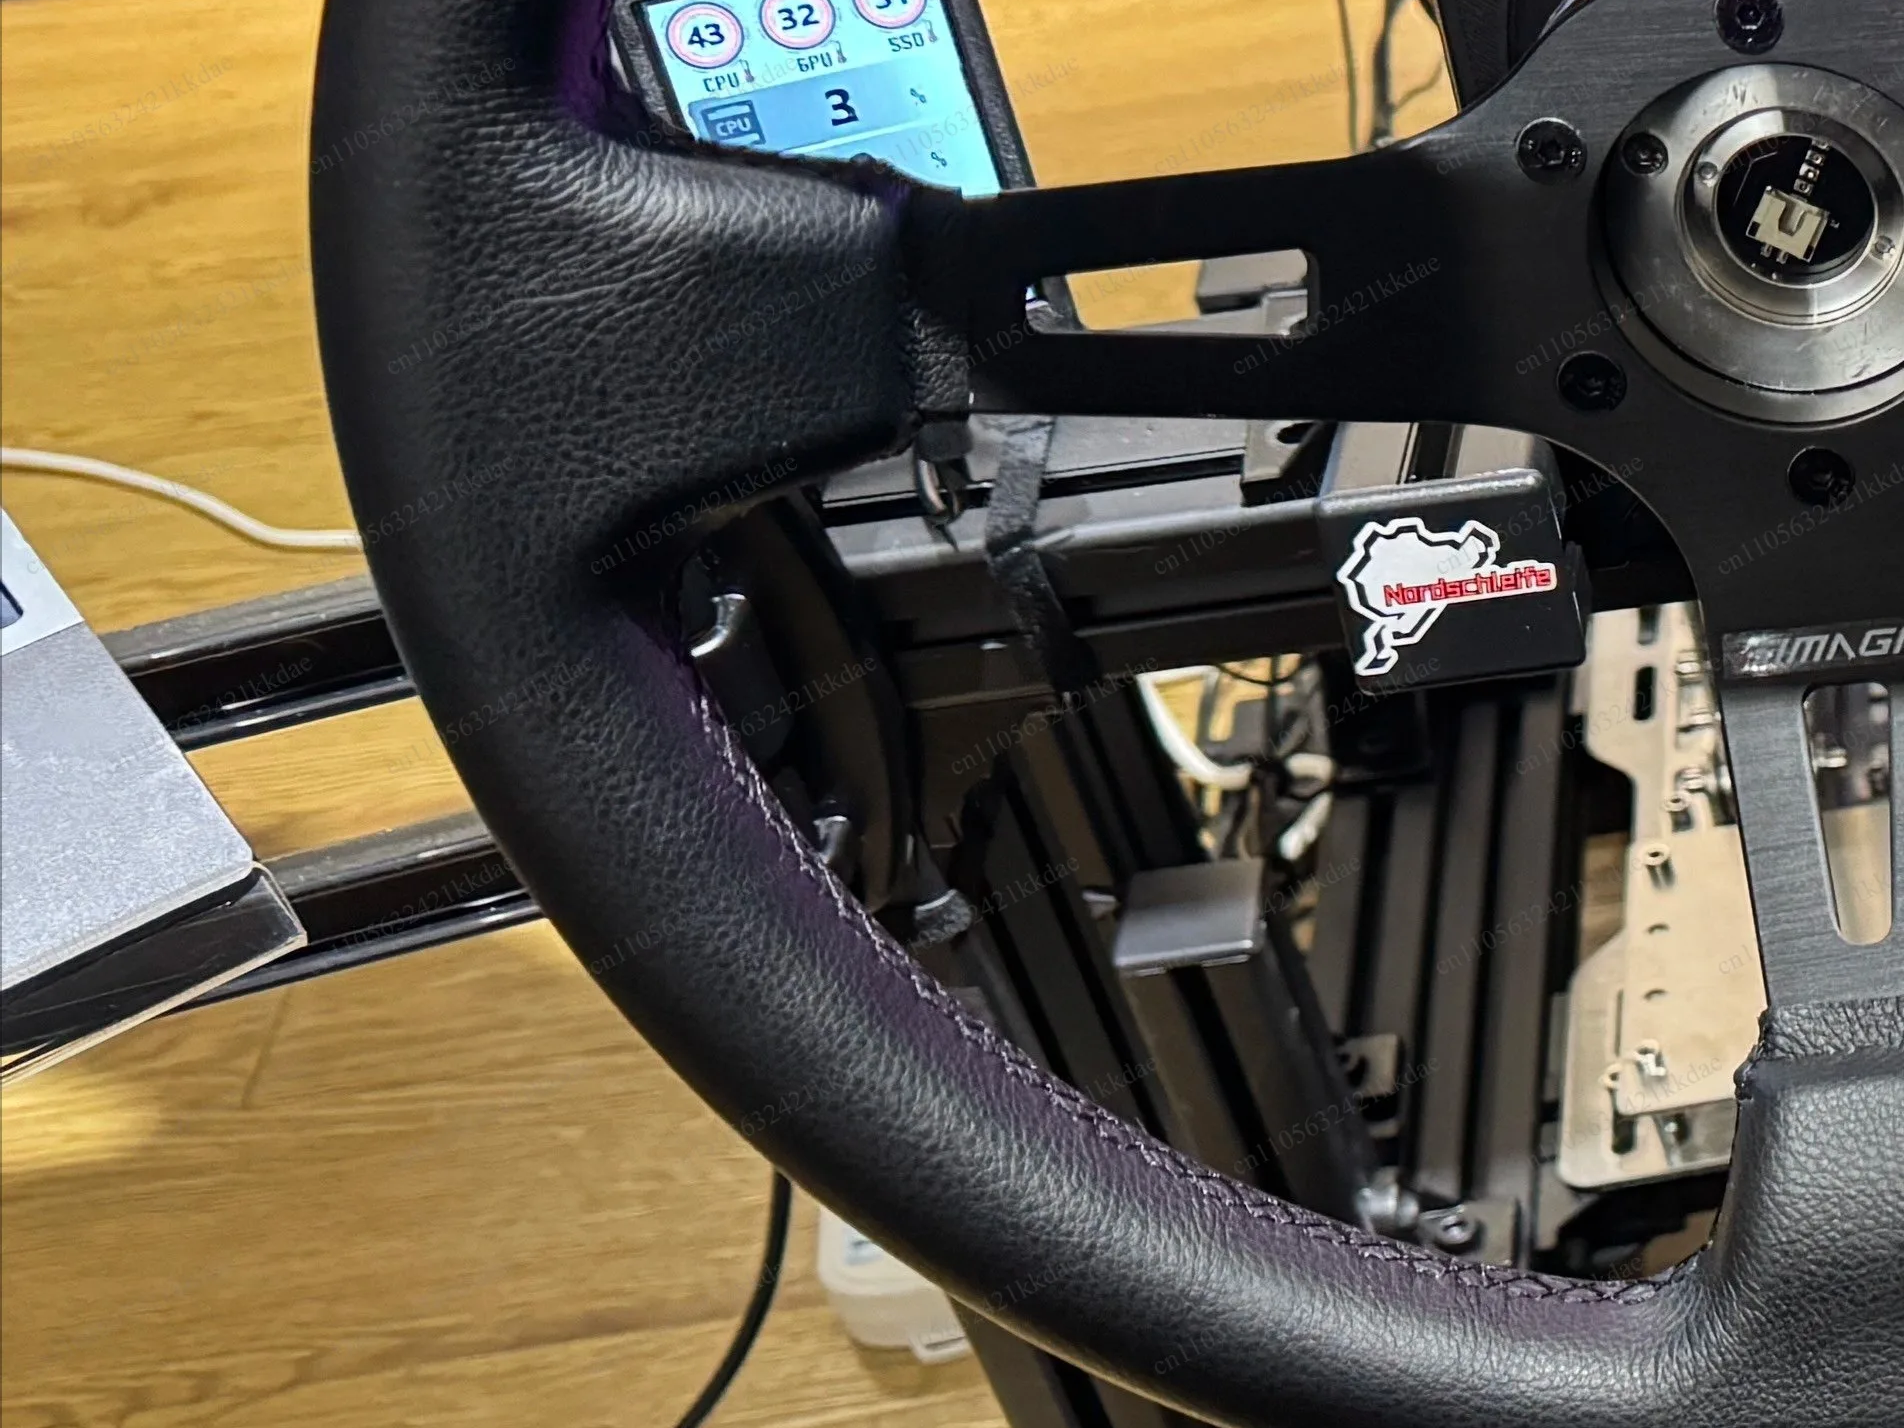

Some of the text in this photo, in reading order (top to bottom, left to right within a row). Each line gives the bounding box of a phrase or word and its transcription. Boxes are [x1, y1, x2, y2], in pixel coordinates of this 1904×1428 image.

[777, 3, 821, 31] 32
[687, 22, 726, 49] 43
[887, 32, 925, 53] SSD
[796, 51, 833, 73] GPU
[702, 72, 740, 94] CPU
[824, 88, 860, 127] 3
[714, 116, 752, 139] CPU
[1383, 565, 1552, 607] Nordschleife
